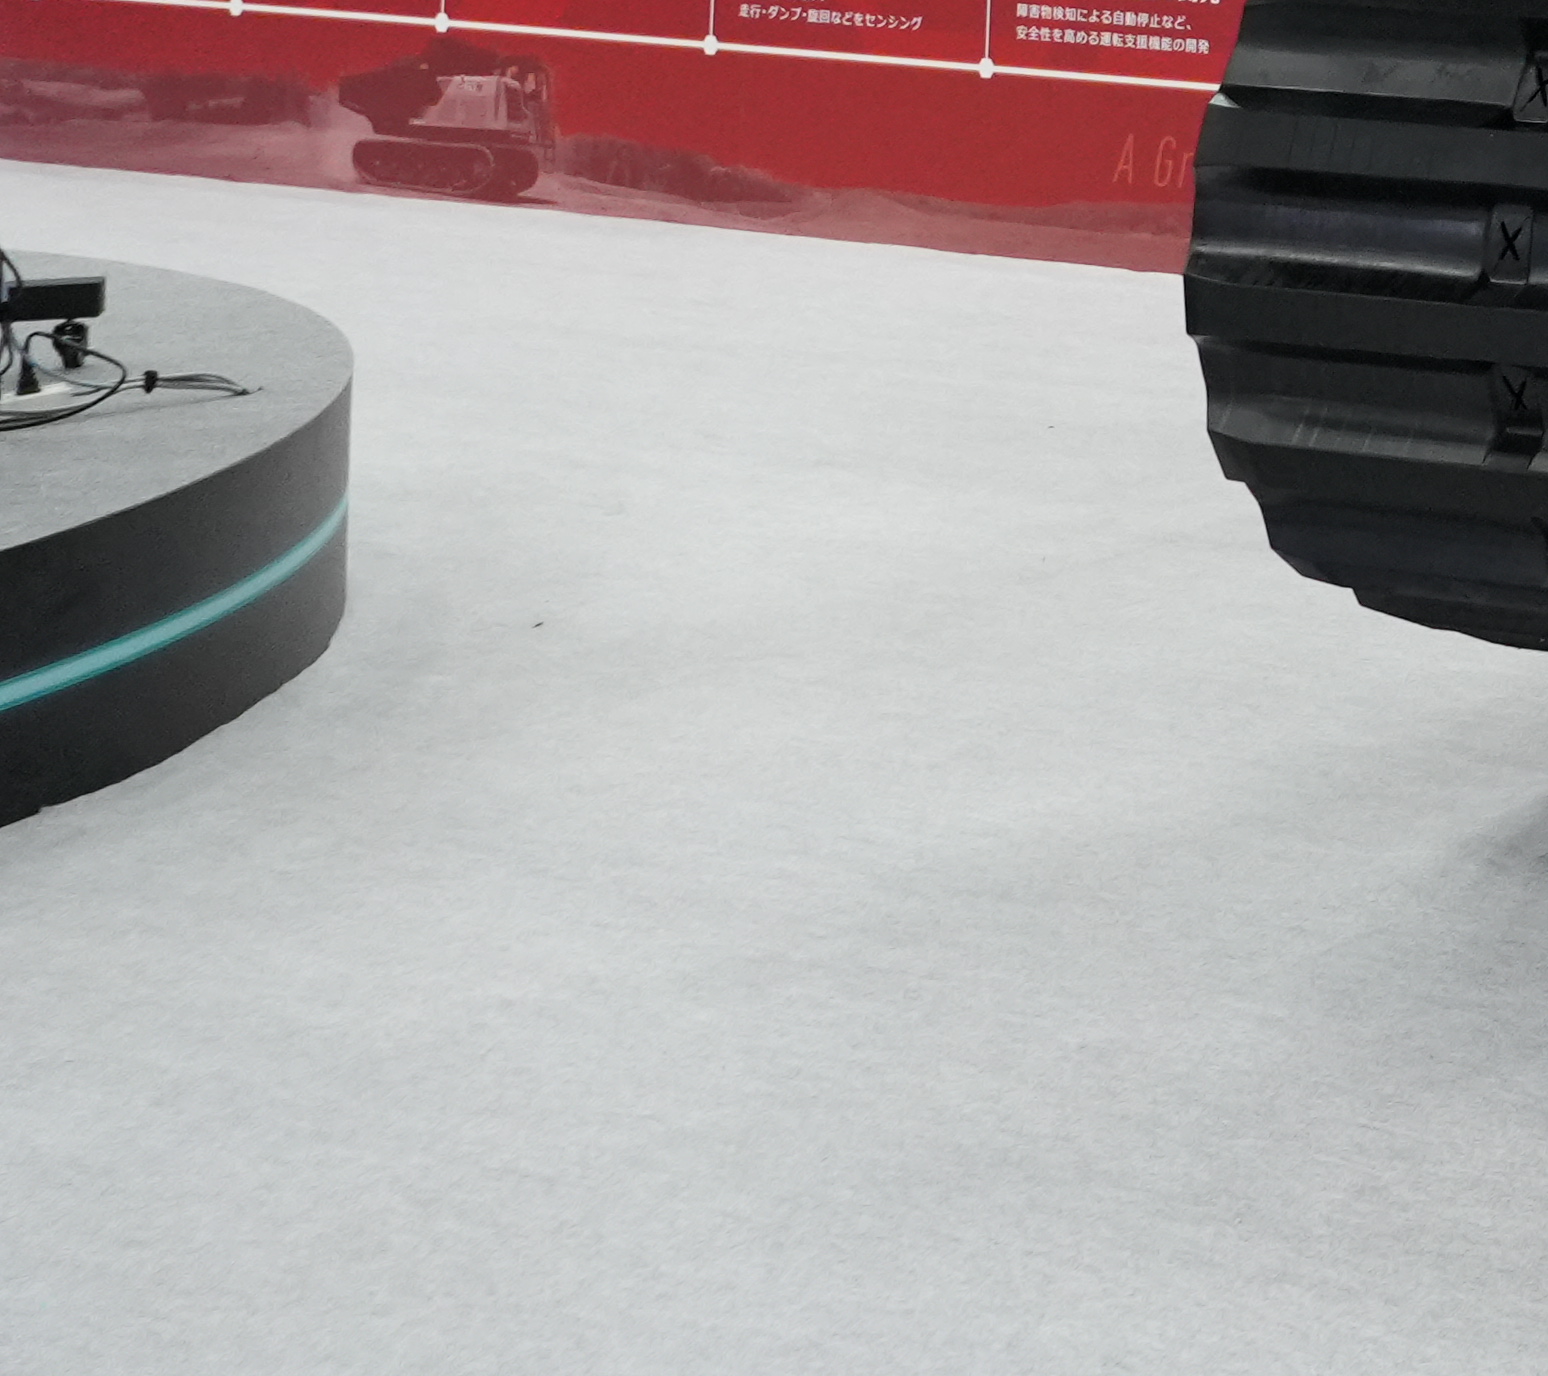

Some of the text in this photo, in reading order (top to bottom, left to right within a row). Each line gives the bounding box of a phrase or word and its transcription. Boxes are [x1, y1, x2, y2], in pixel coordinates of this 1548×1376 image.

[1016, 3, 1192, 31] 障害物検知による自動停止など、
[1016, 25, 1210, 55] 安全性を高める運転支援機能の開発
[1112, 133, 1134, 184] A
